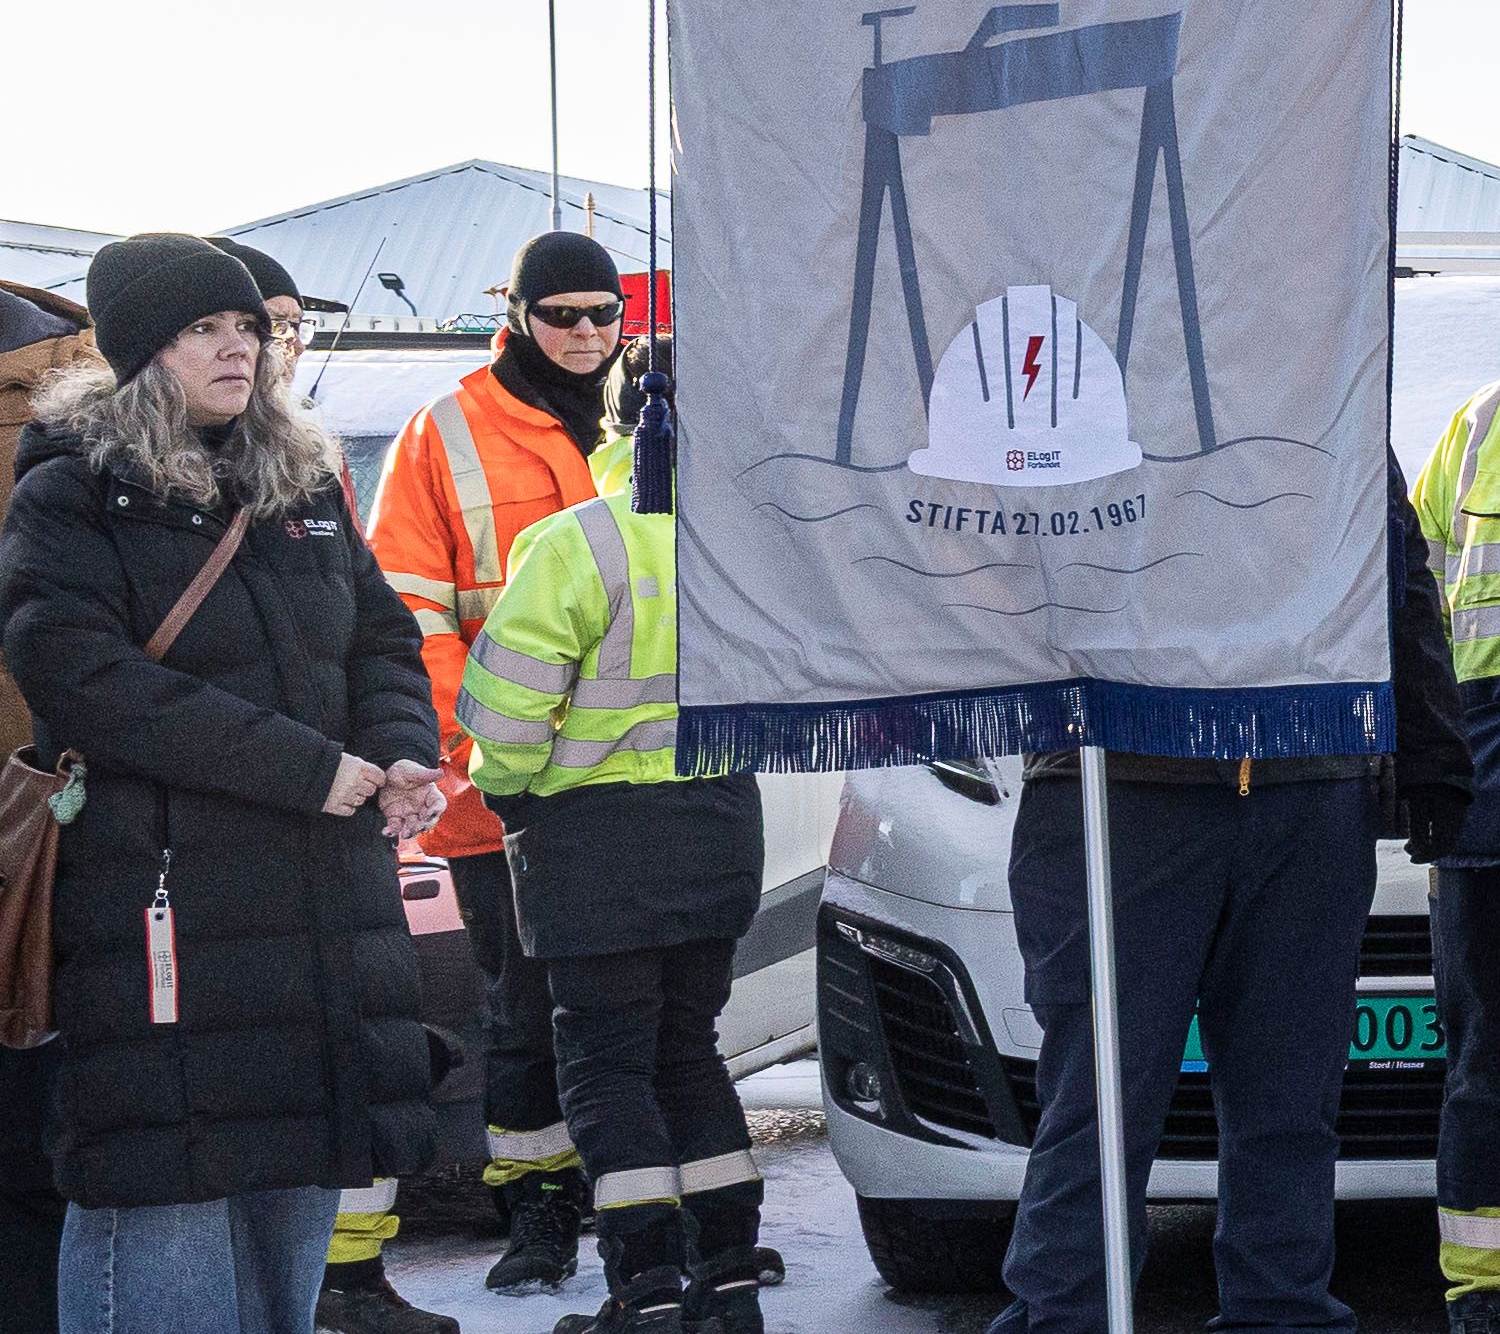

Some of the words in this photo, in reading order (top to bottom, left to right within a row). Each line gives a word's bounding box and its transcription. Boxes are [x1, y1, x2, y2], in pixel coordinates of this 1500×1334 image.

[906, 498, 1007, 536] STIFTA
[1013, 494, 1147, 536] 27.02.1967
[1351, 1004, 1447, 1052] 003
